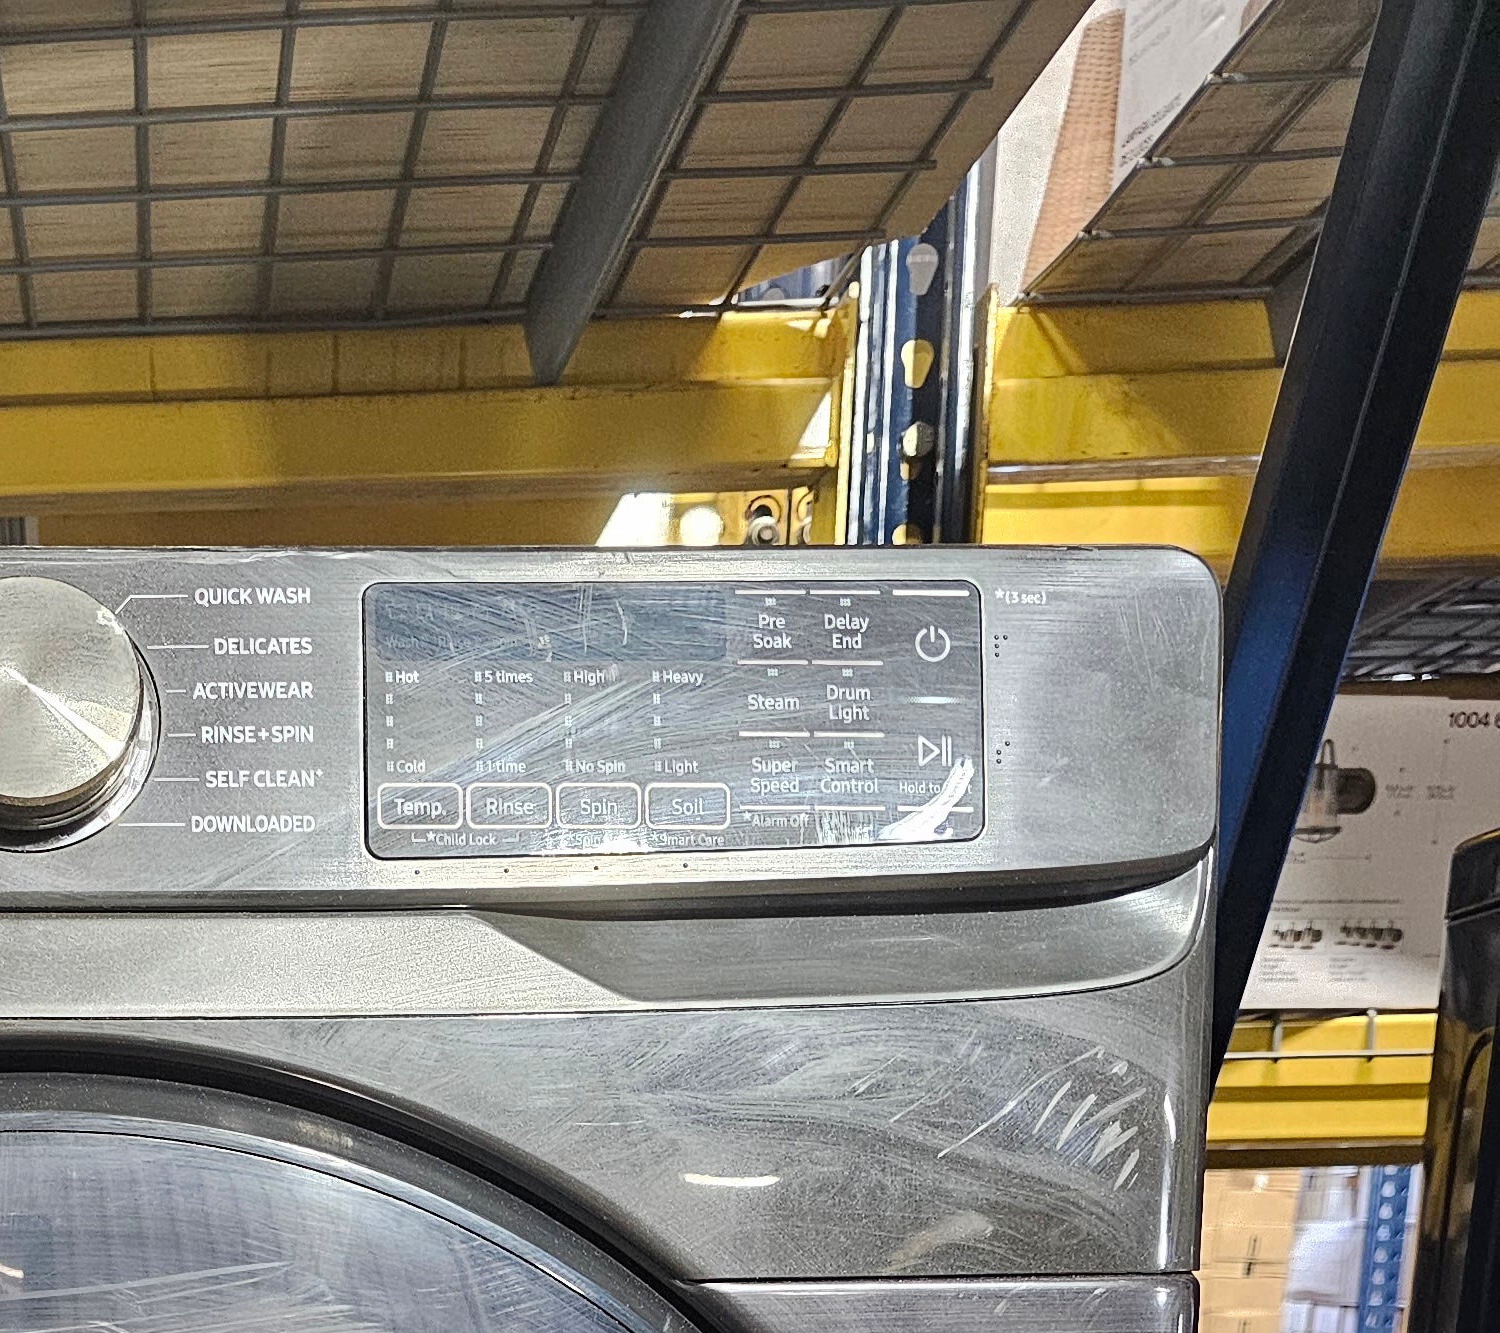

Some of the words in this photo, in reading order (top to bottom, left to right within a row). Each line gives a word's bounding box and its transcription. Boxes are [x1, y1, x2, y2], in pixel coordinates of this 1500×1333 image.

[194, 587, 252, 607] QUICK
[255, 587, 311, 604] WASH
[1021, 591, 1047, 605] sec)
[758, 613, 786, 629] Pre
[824, 613, 870, 632] Delay
[213, 637, 313, 655] DELICATES
[753, 632, 793, 649] Soak
[832, 633, 862, 649] End
[395, 670, 420, 684] Hot
[484, 670, 493, 684] 5
[495, 670, 534, 684] times
[573, 670, 606, 685] High
[662, 670, 704, 686] Heavy
[193, 681, 314, 700] ACTIVEWEAR
[826, 684, 871, 700] Drum
[747, 694, 800, 711] Steam
[829, 703, 870, 724] Light
[1449, 711, 1490, 728] 1004
[200, 725, 314, 744] RINSE+SPIN
[396, 760, 426, 773] Cold
[495, 760, 527, 773] time
[575, 760, 595, 773] No
[596, 760, 626, 774] Spin
[664, 760, 700, 775] Light
[751, 757, 799, 775] Super
[824, 757, 875, 774] Smart
[205, 769, 250, 788] SELF
[750, 777, 800, 796] Speed
[820, 777, 879, 794] Control
[899, 782, 927, 795] Hold
[928, 782, 941, 795] to
[394, 798, 447, 818] Temp.
[485, 797, 535, 817] Rinse
[580, 797, 619, 818] Spin
[671, 797, 705, 815] Soil
[190, 814, 316, 833] DOWNLOADED
[790, 813, 811, 827] Off
[468, 831, 496, 846] Lock
[699, 834, 725, 847] Care
